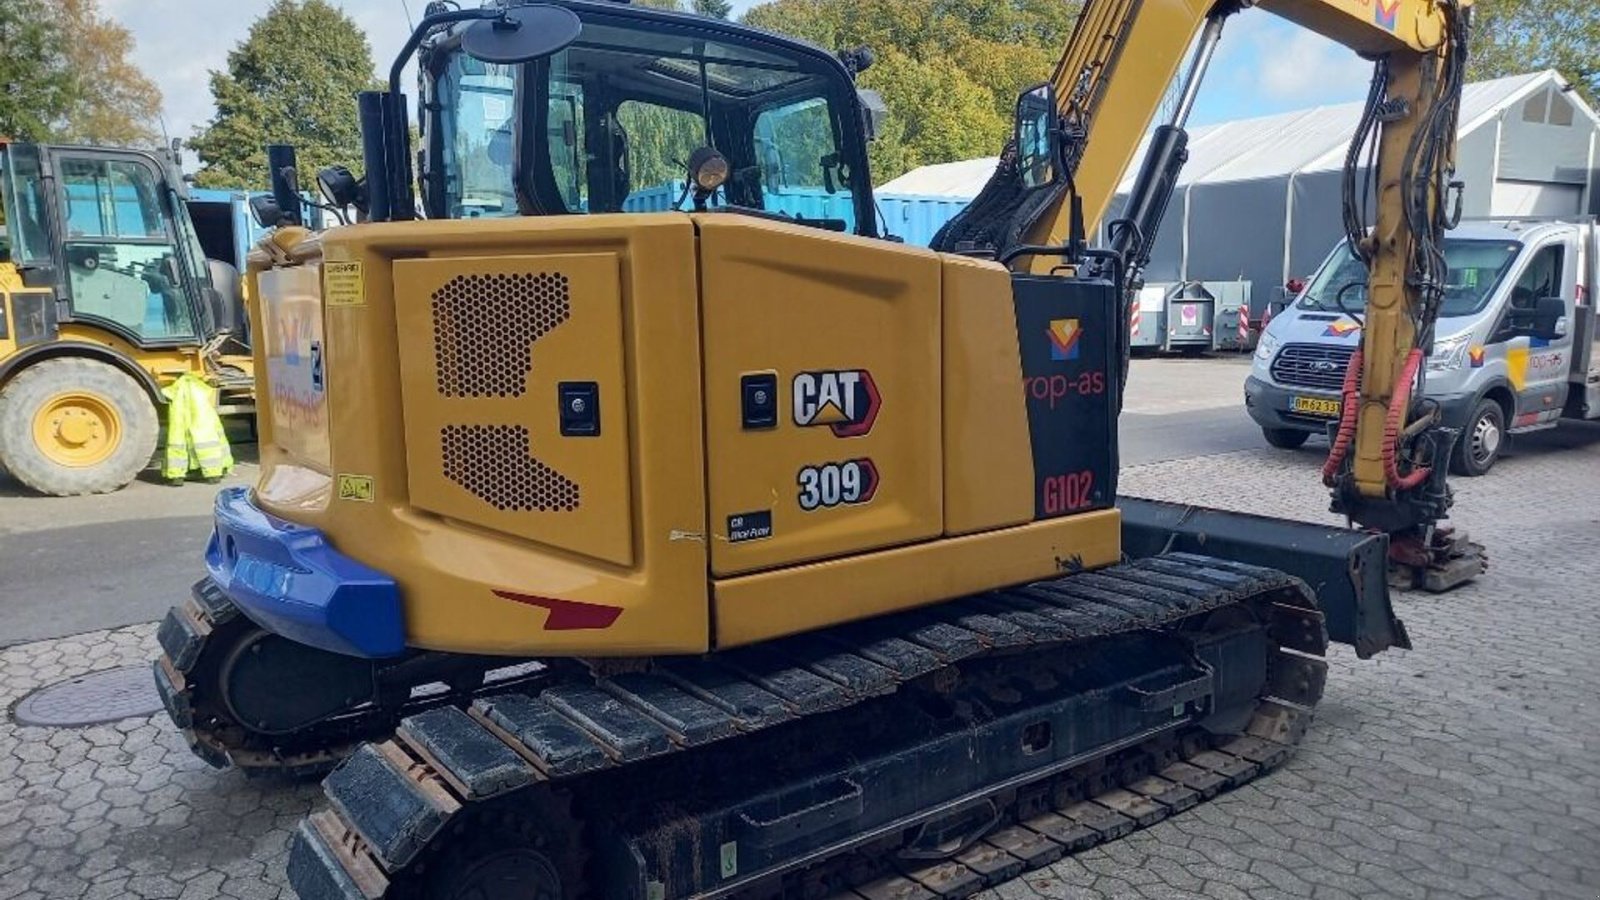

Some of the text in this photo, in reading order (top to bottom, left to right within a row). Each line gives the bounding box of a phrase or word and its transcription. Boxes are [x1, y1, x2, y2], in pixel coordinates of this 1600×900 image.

[793, 371, 860, 426] CAT
[1023, 371, 1105, 410] rop-as
[799, 461, 860, 509] 309
[1043, 469, 1093, 515] G102
